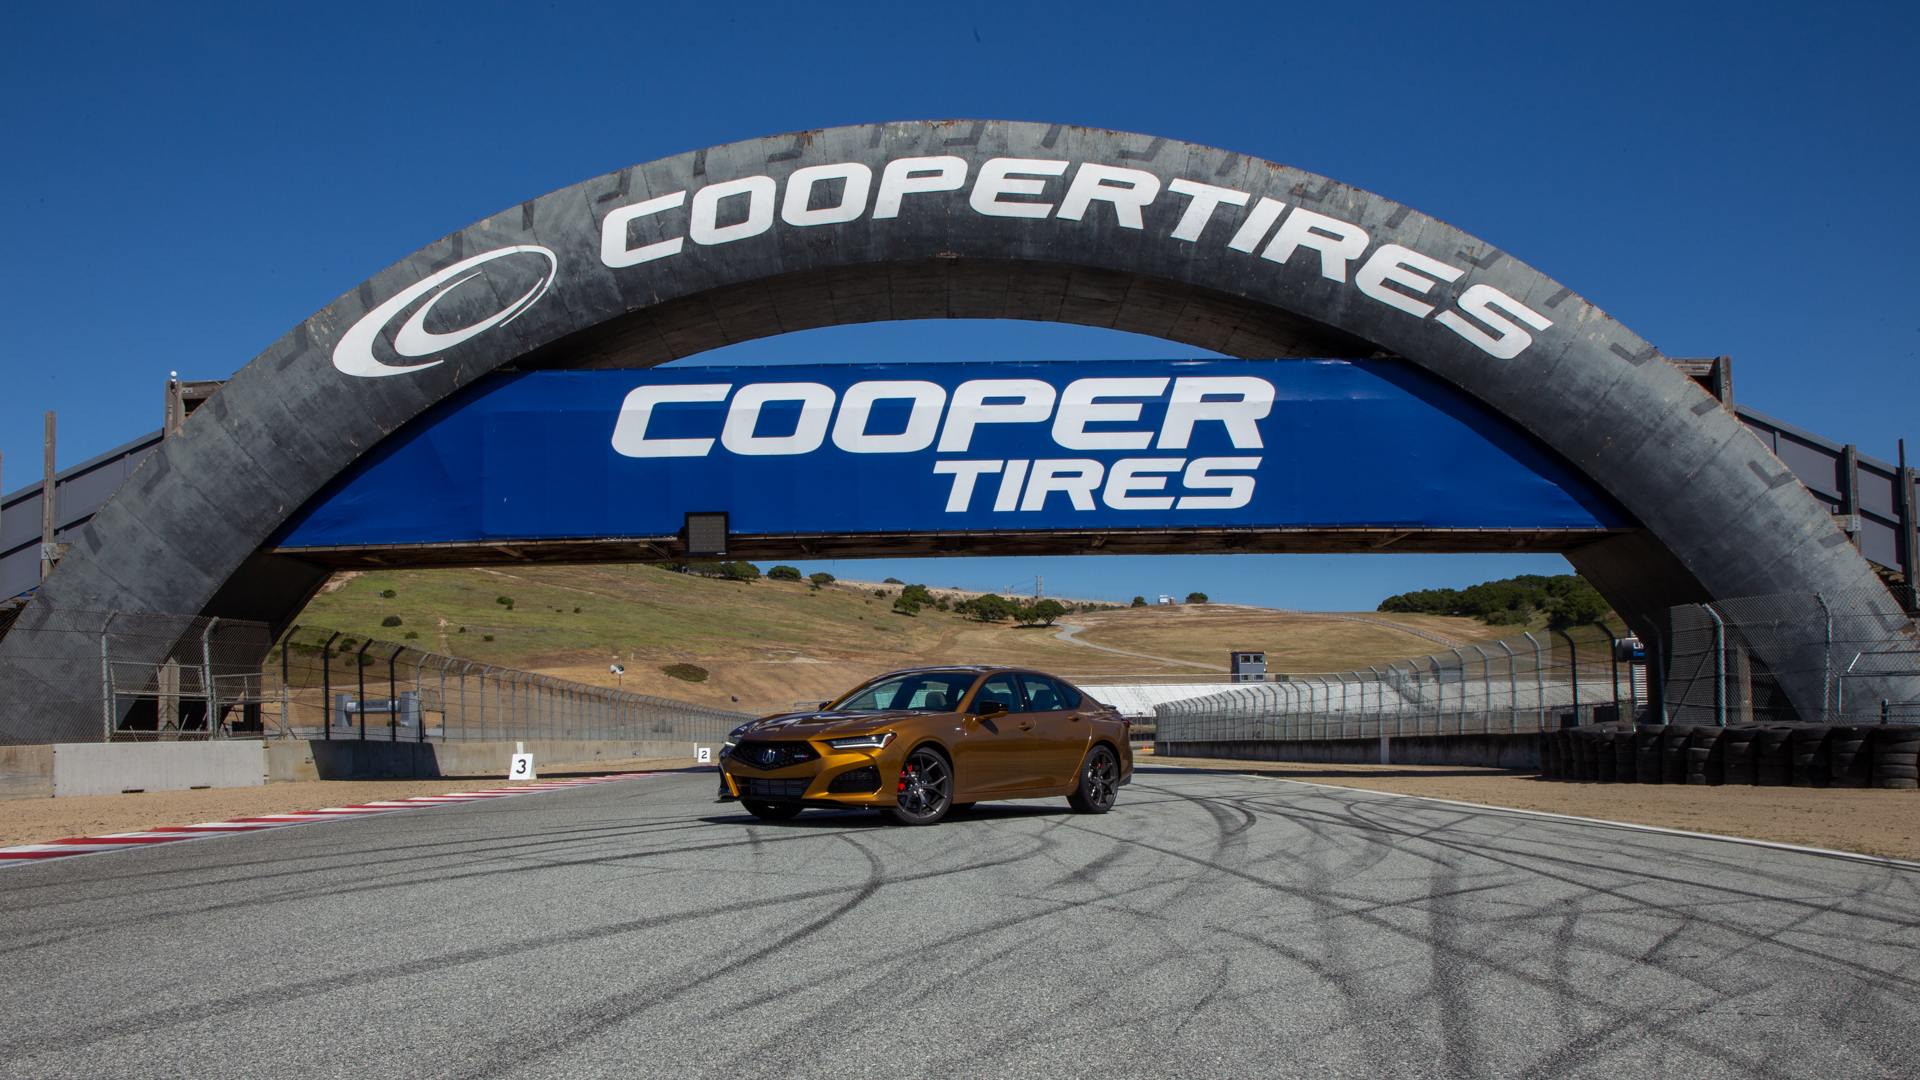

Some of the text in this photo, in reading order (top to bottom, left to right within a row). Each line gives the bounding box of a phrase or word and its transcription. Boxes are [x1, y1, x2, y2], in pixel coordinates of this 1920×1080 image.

[611, 376, 1276, 458] COOPER
[932, 456, 1263, 513] TIRES
[516, 759, 527, 774] 3
[701, 750, 708, 759] 2
